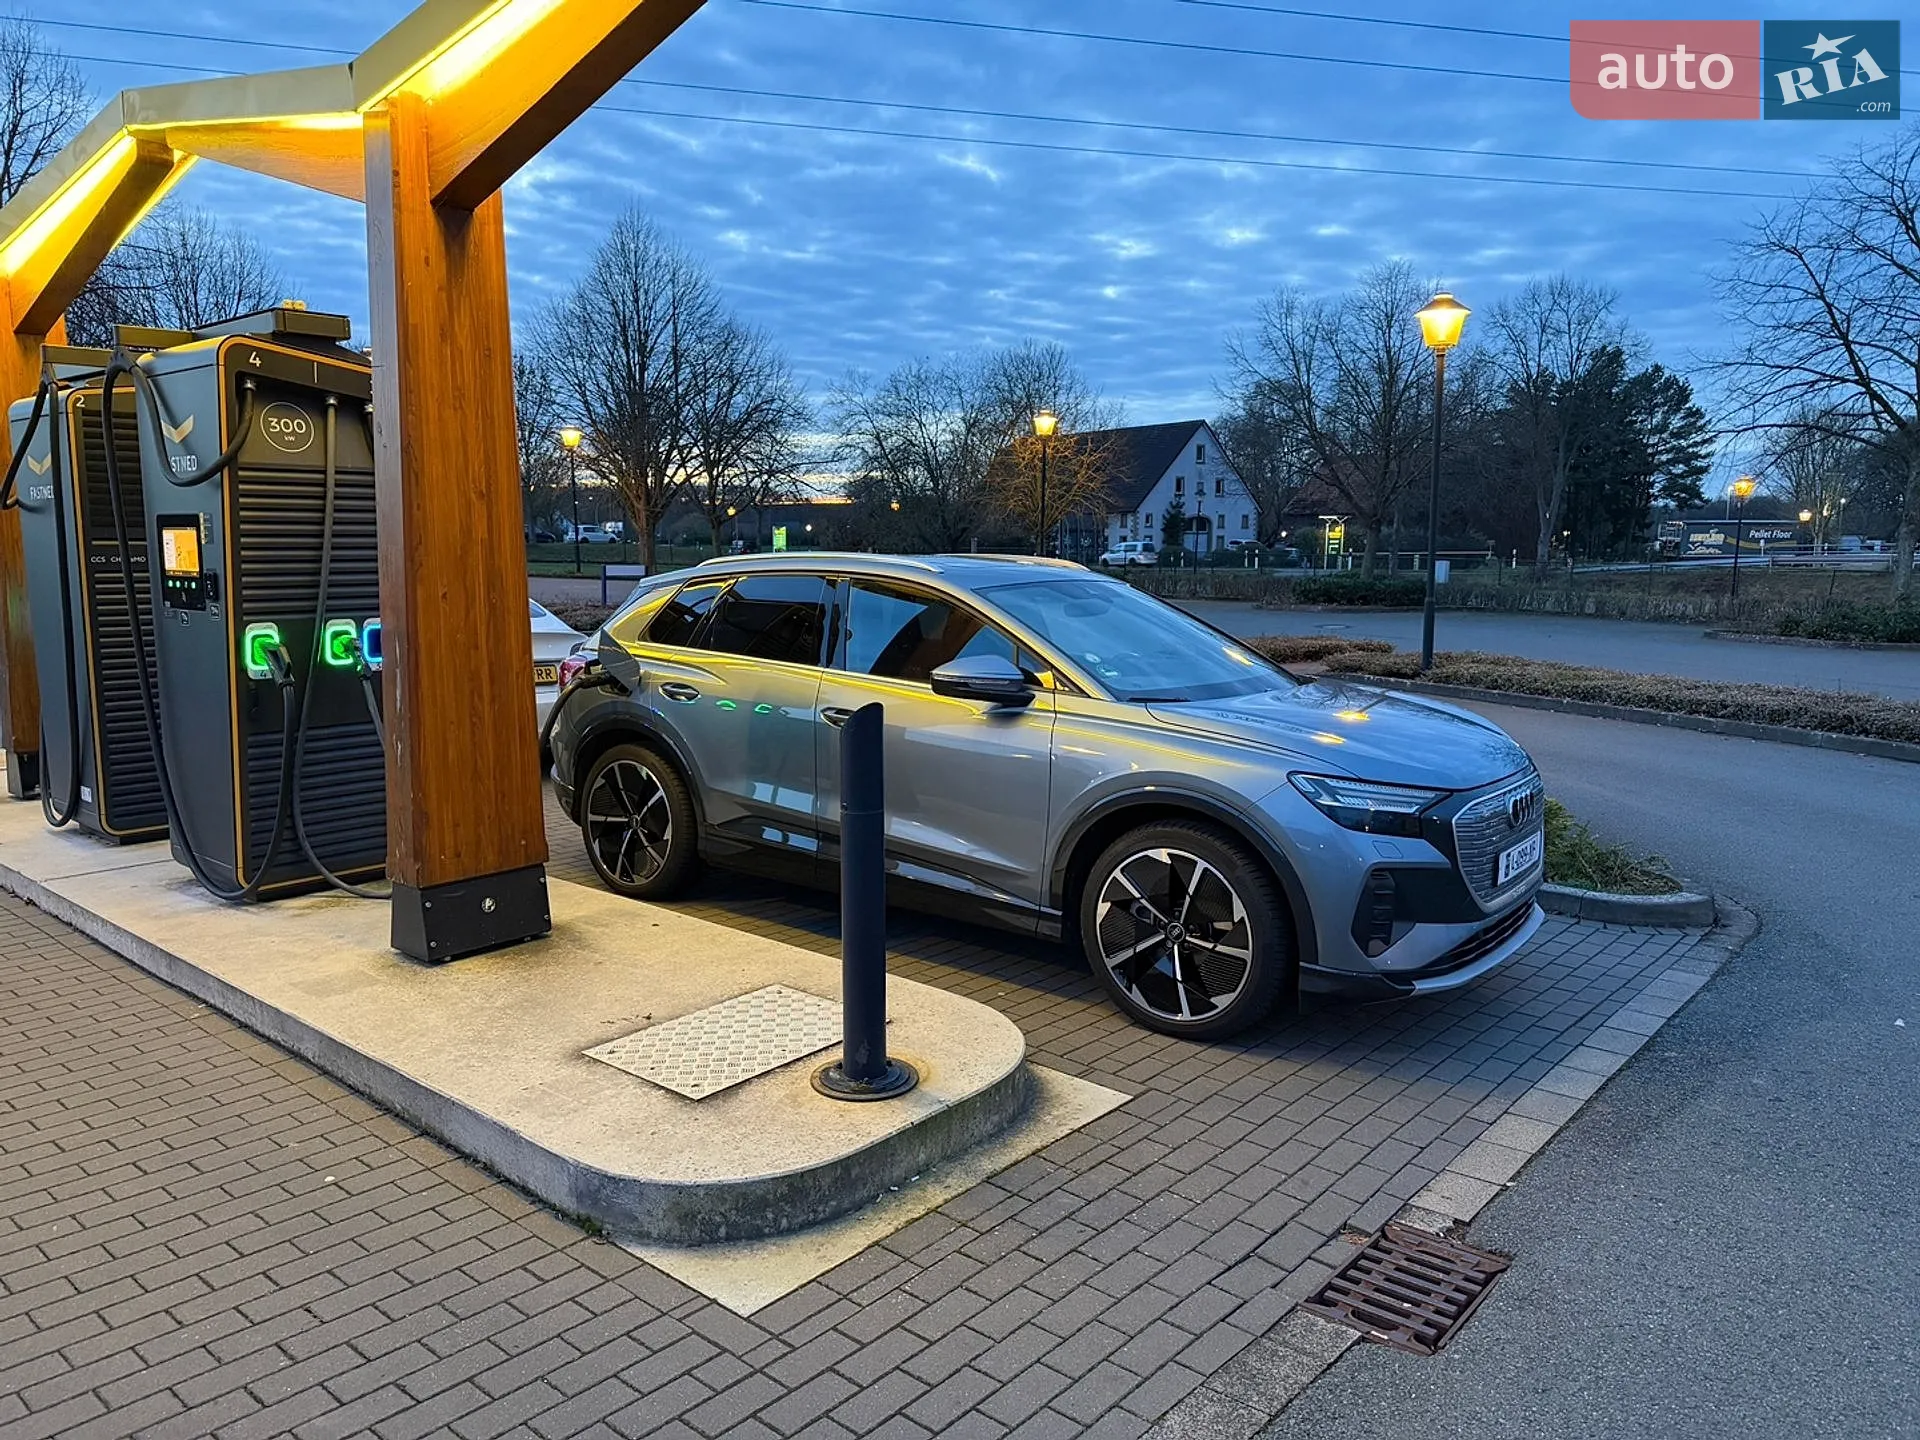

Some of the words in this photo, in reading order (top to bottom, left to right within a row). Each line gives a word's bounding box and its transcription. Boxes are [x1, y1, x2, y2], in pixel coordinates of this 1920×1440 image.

[249, 351, 262, 367] 4
[76, 394, 86, 408] 2
[267, 417, 306, 434] 300
[1749, 530, 1772, 539] Pellet
[1772, 530, 1793, 539] Floor
